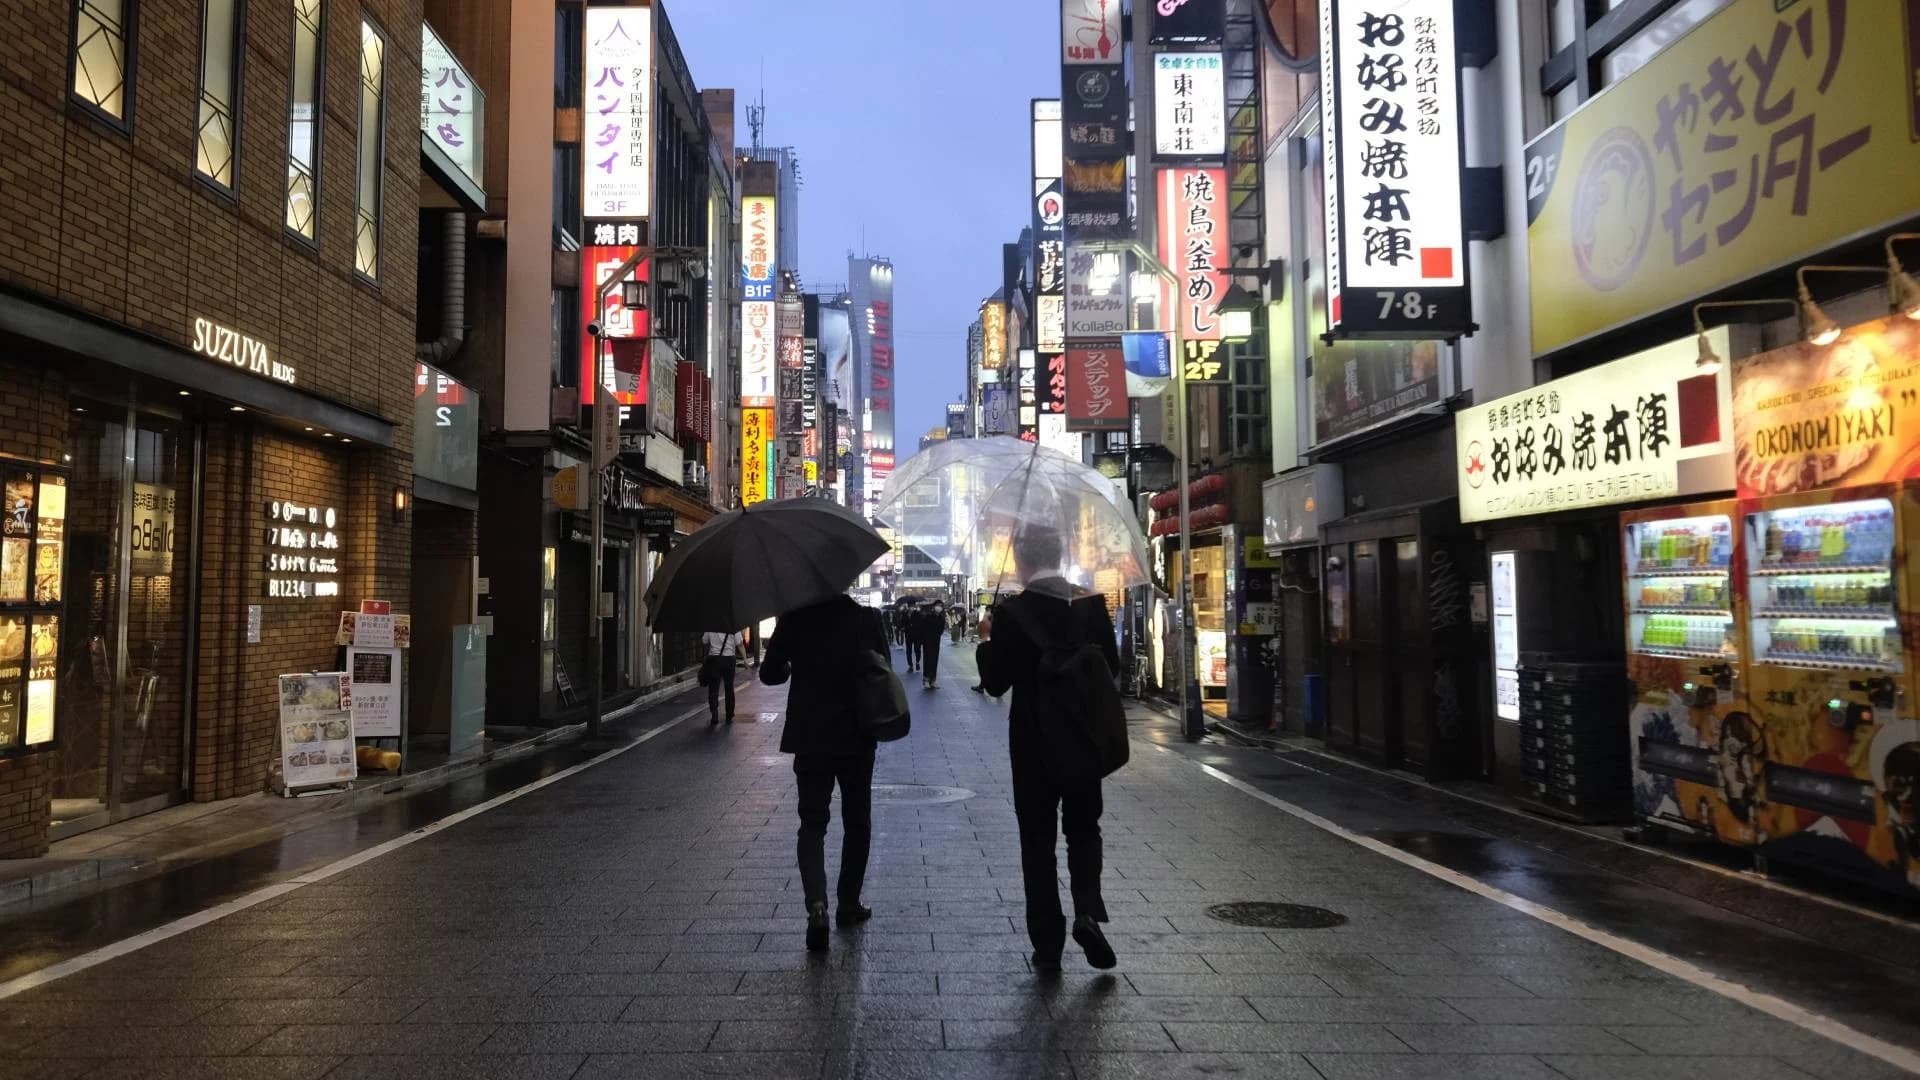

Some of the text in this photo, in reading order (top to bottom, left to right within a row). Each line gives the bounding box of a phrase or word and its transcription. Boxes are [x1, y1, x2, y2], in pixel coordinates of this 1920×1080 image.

[1159, 57, 1220, 69] 全卓全自動
[1653, 0, 1848, 173] やきとり
[593, 66, 625, 175] バンタイ
[630, 67, 643, 167] タイ国料理専門店
[1172, 73, 1194, 151] 東南荘
[1356, 11, 1414, 267] お好み焼本陣
[1527, 156, 1557, 200] 2F
[1661, 113, 1873, 267] センター
[603, 200, 627, 213] 3F
[594, 224, 639, 246] 焼肉
[750, 201, 769, 279] まぐろ商店
[1183, 170, 1217, 333] 焼鳥釜めし
[743, 285, 772, 297] B1F
[192, 317, 296, 385] SUZUYA BLDG
[1071, 320, 1124, 333] KollaBo
[1185, 340, 1220, 359] 1F
[1185, 361, 1222, 380] 2F
[685, 384, 694, 430] ANRAKUTEI
[1756, 403, 1895, 458] OKONOMIYAKI
[1490, 392, 1671, 486] お好み焼本陣
[308, 507, 318, 524] 10
